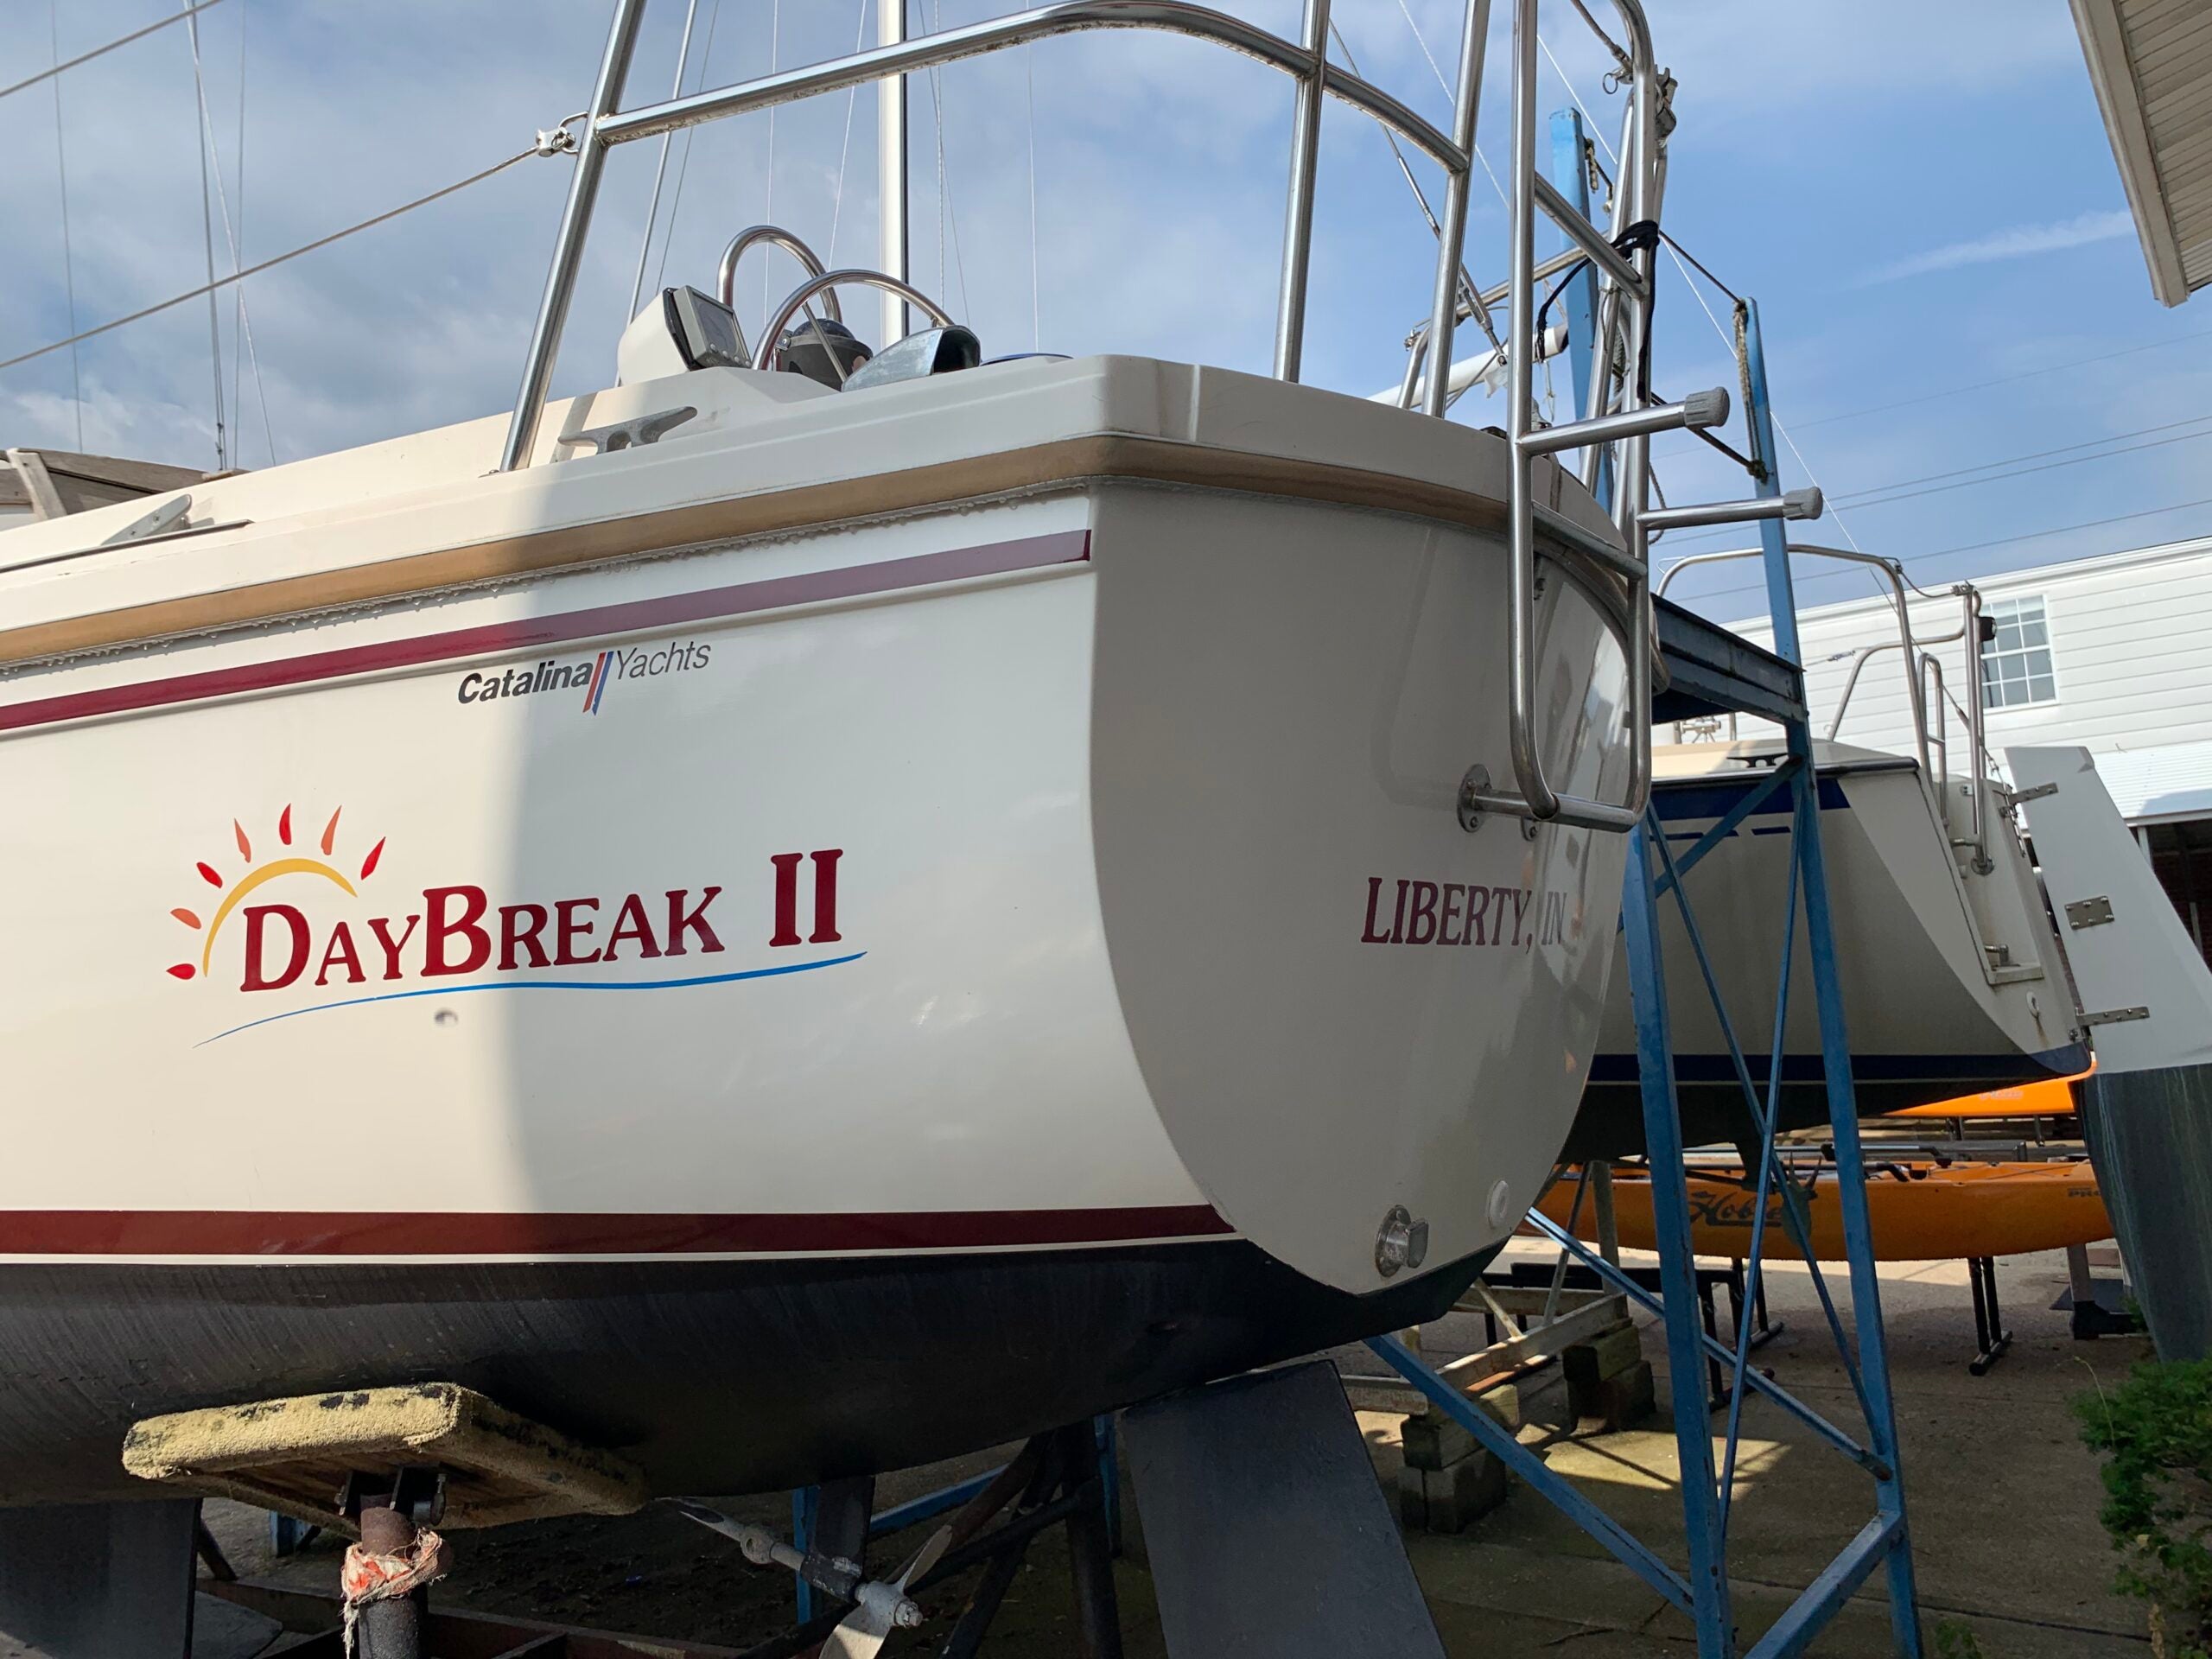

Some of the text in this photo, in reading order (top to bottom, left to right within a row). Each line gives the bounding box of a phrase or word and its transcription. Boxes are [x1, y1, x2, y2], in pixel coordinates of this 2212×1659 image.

[458, 641, 711, 704] Catalina Yachts
[768, 849, 844, 947] II
[1361, 877, 1567, 954] LIBERTY, IN
[1689, 1192, 1783, 1226] Hobe
